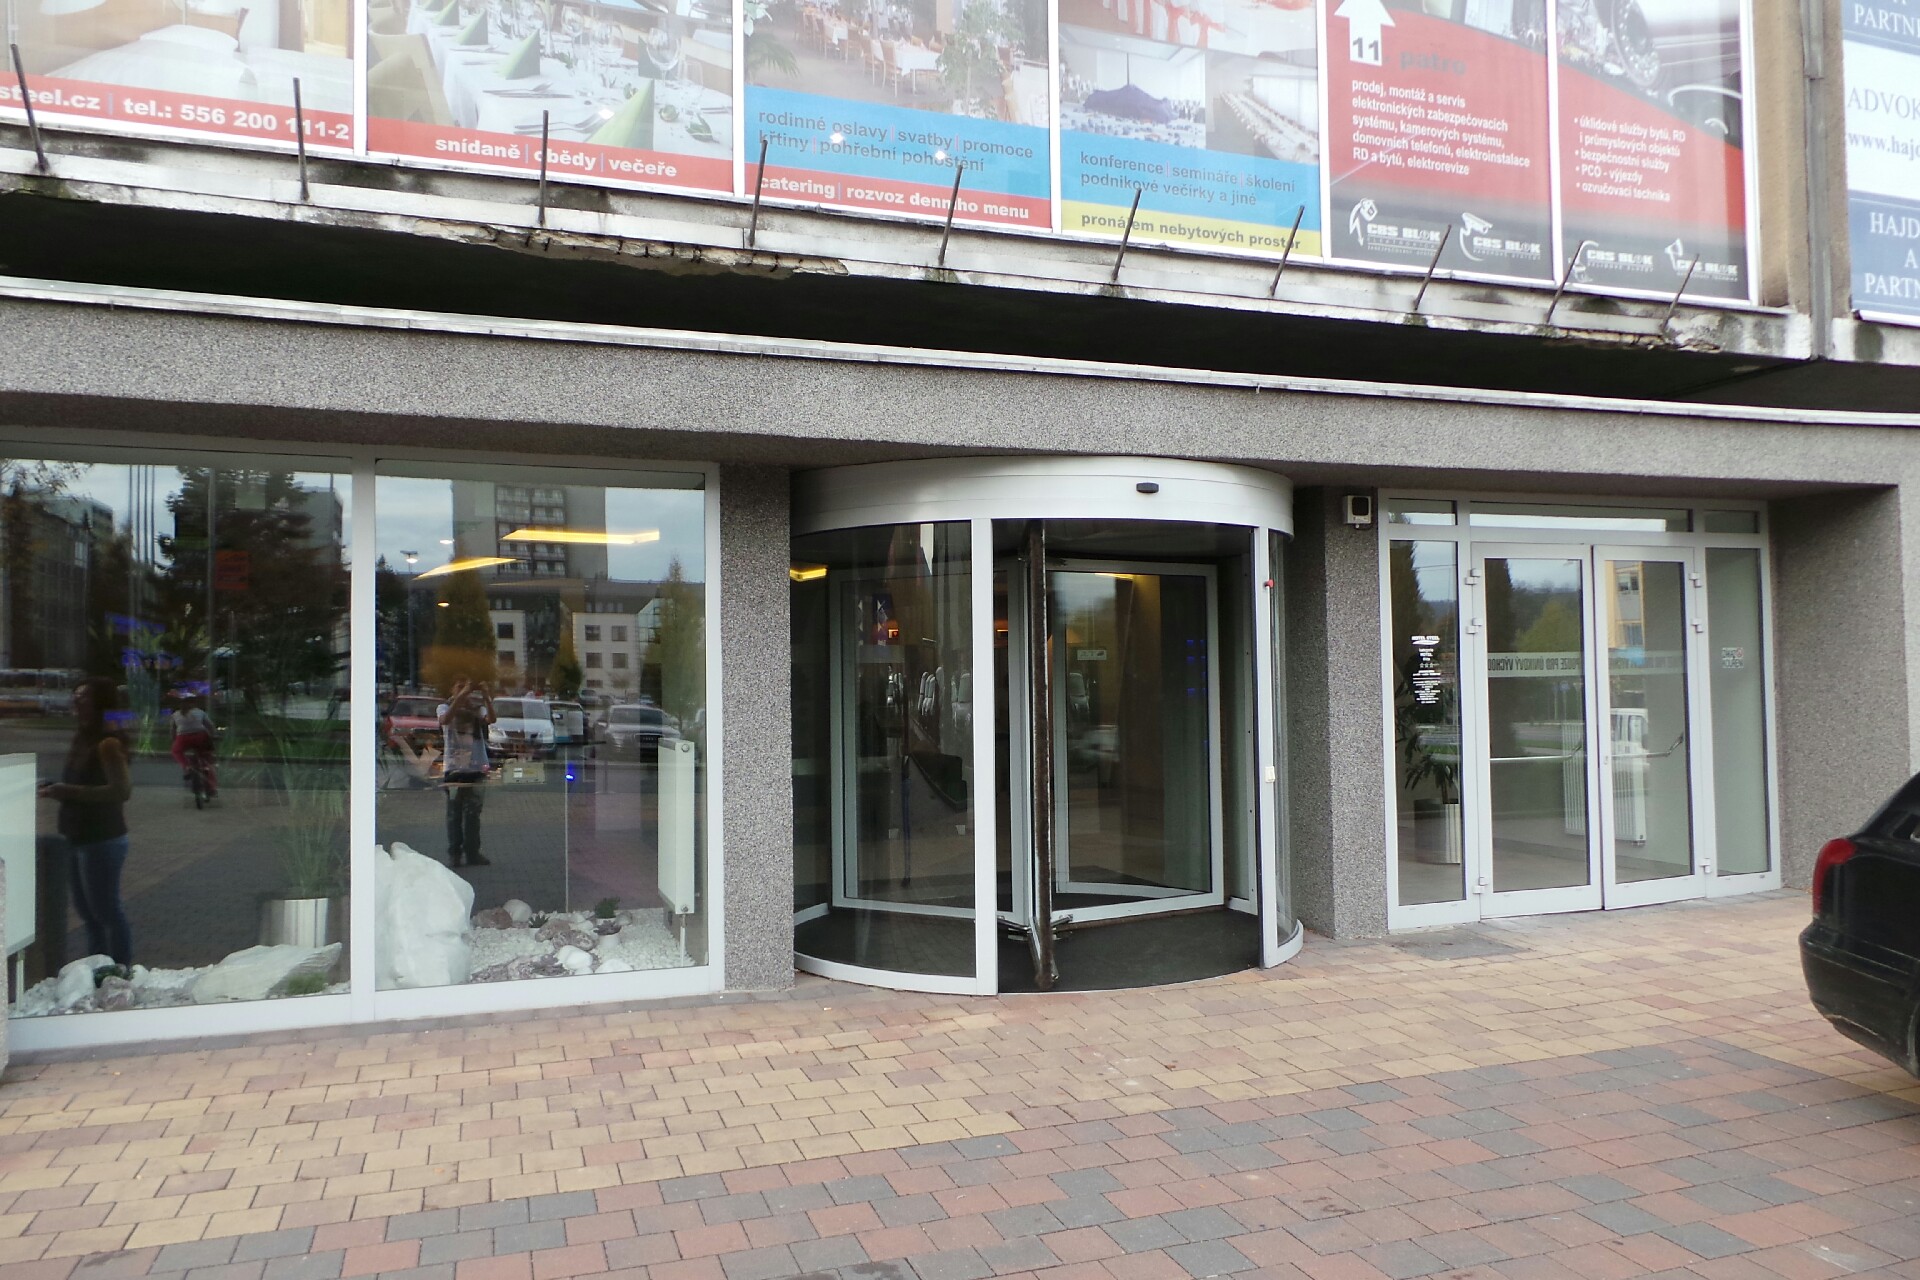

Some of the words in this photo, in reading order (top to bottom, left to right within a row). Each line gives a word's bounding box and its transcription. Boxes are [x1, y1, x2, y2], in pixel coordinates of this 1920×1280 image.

[1399, 51, 1467, 75] patro
[1352, 80, 1386, 97] prodej,
[1389, 86, 1426, 101] montáž
[1428, 92, 1434, 103] a
[1436, 94, 1466, 108] servis
[123, 98, 172, 118] tel.:
[180, 104, 226, 124] 556
[233, 110, 277, 131] 200
[285, 118, 349, 140] 111-2
[1352, 95, 1425, 119] elektronických
[1427, 109, 1508, 132] zabezpečovacích
[759, 111, 826, 131] rodinné
[832, 122, 887, 142] oslavy
[898, 131, 952, 150] svatby
[963, 138, 1033, 158] promoce
[1352, 114, 1397, 133] systému,
[1400, 119, 1460, 142] kamerových
[1580, 115, 1617, 132] úklidové
[1619, 122, 1648, 139] služby
[1673, 129, 1686, 142] RD
[435, 138, 521, 159] snídaně
[533, 148, 597, 171] obědy
[608, 157, 677, 177] večeře
[759, 130, 808, 152] křtiny
[820, 139, 896, 160] pohřební
[1352, 130, 1408, 150] domovních
[1455, 145, 1530, 168] elektroinstalace
[1584, 133, 1647, 153] průmyslových
[1648, 142, 1681, 157] objektů
[1080, 151, 1164, 174] konference
[1172, 166, 1238, 185] semináře
[1246, 174, 1295, 193] školení
[1353, 146, 1369, 161] RD
[1371, 152, 1378, 162] a
[1407, 155, 1470, 175] elektrorevize
[1580, 147, 1640, 167] bezpečnostní
[1641, 157, 1670, 173] služby
[1581, 163, 1602, 178] PCO
[1609, 167, 1643, 185] výjezdy
[759, 177, 835, 199] catering
[847, 186, 905, 204] rozvoz
[909, 192, 979, 214] dennho
[984, 204, 1029, 219] menu
[1081, 173, 1159, 193] podnikové
[1163, 183, 1215, 203] večírky
[1219, 191, 1227, 201] a
[1231, 190, 1257, 206] jiné
[1582, 182, 1632, 197] ozvučovací
[1633, 187, 1671, 203] technika
[1081, 214, 1154, 232] pronáem
[1159, 223, 1244, 243] nebytových
[1367, 223, 1398, 236] CBS
[1473, 236, 1502, 249] CBS
[1587, 249, 1615, 261] CBS
[1904, 248, 1918, 269] A
